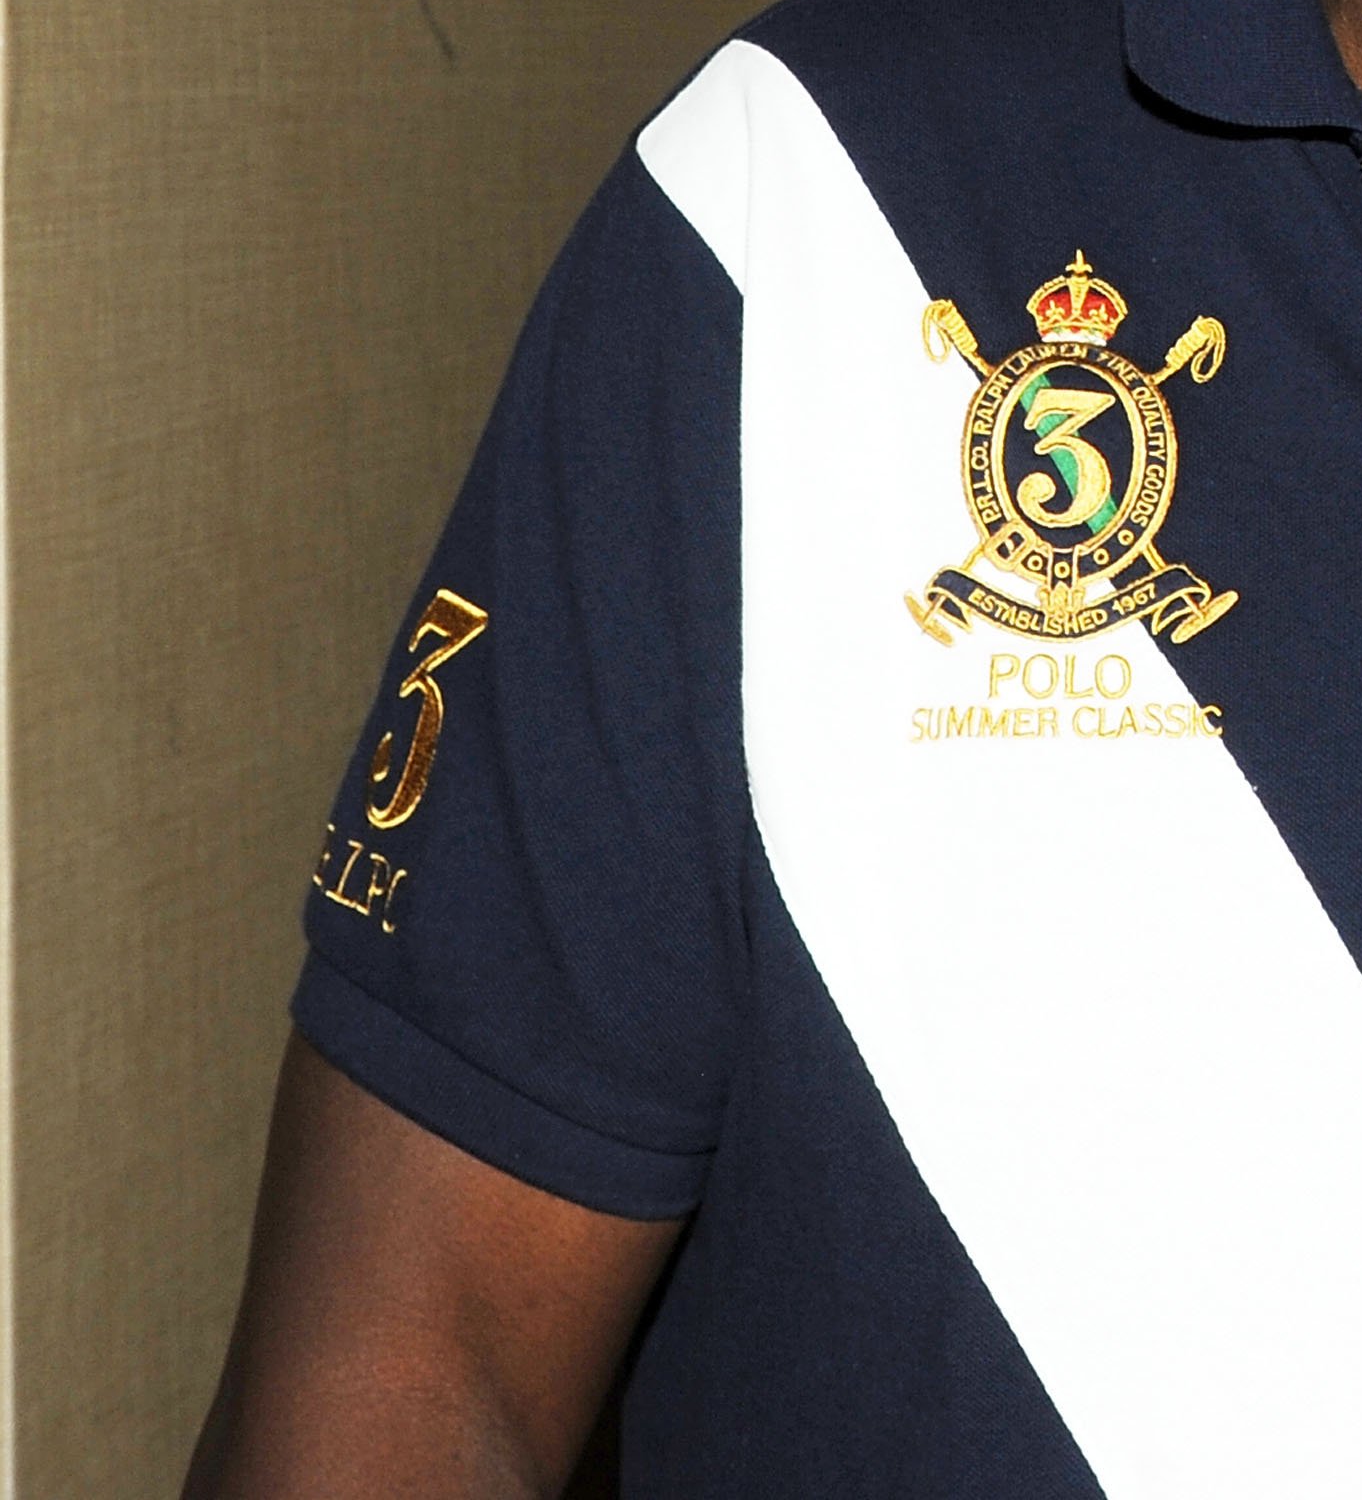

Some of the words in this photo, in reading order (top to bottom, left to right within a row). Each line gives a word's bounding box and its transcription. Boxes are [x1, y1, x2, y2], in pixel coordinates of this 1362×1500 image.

[1010, 344, 1088, 376] LAUREN
[1096, 351, 1138, 386] FINE
[975, 368, 1013, 437] RALPH
[1131, 385, 1167, 463] QUALITY
[1016, 388, 1116, 528] 3
[1130, 464, 1166, 529] GOODS
[968, 588, 1108, 636] ESTABLISHED
[1112, 583, 1158, 616] 1967
[988, 653, 1132, 700] POLO
[366, 589, 489, 829] 3
[910, 704, 1060, 742] SUMMER
[1072, 703, 1225, 739] CLASSIC
